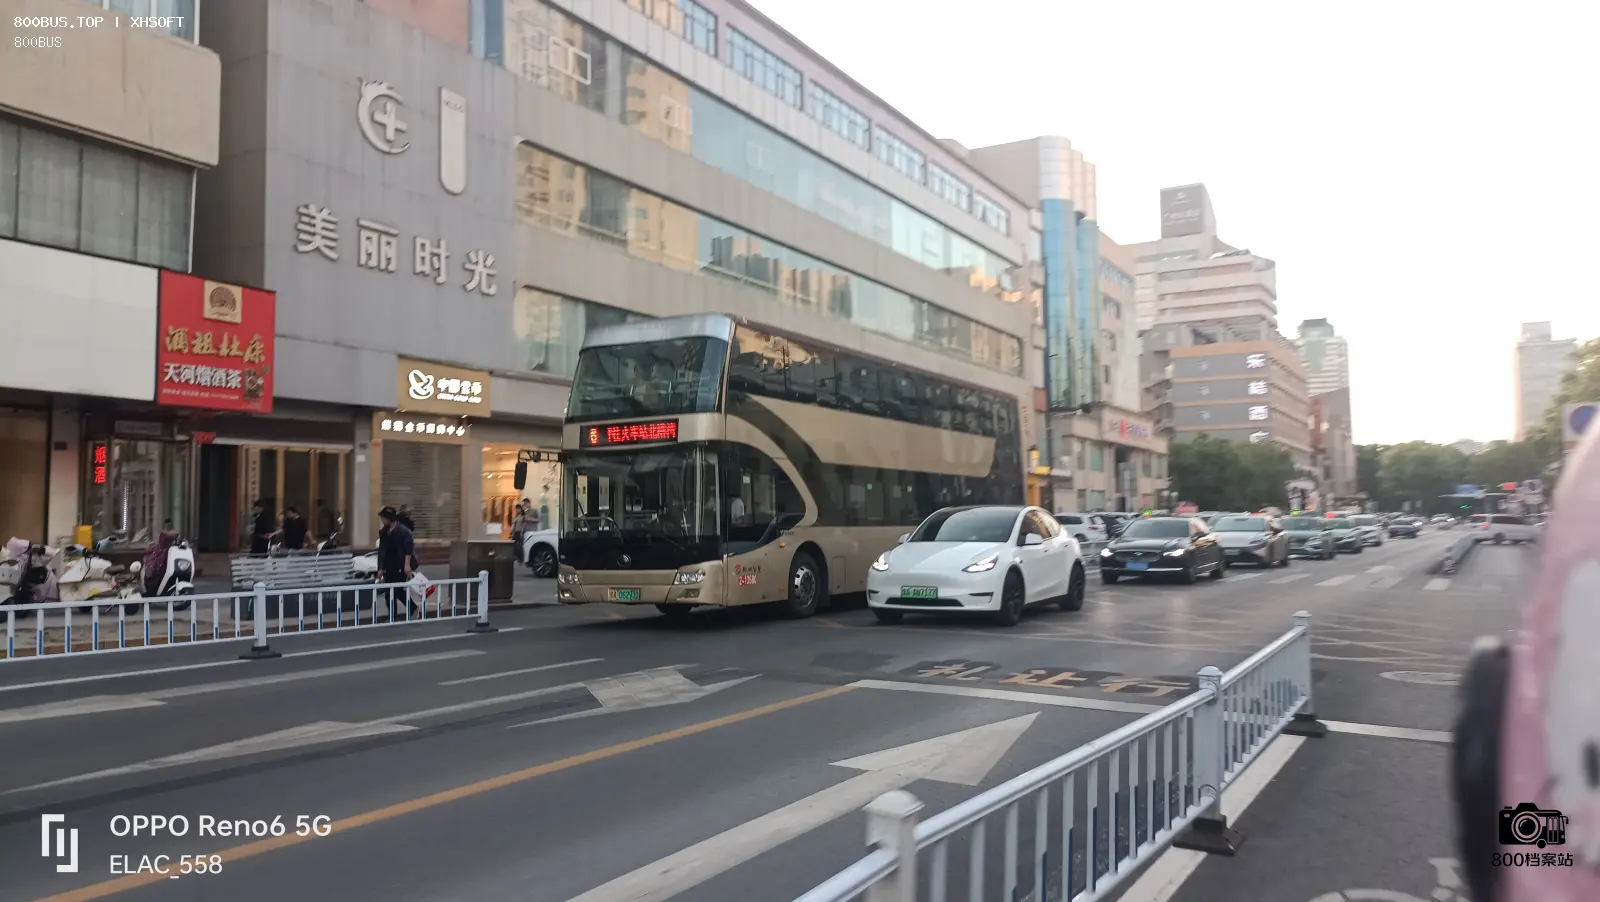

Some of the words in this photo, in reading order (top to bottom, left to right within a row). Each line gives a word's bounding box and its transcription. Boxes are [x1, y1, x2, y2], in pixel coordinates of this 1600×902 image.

[295, 203, 497, 297] 美丽时光
[165, 325, 265, 364] 酒祖杜康
[163, 362, 242, 389] 天河烟酒茶
